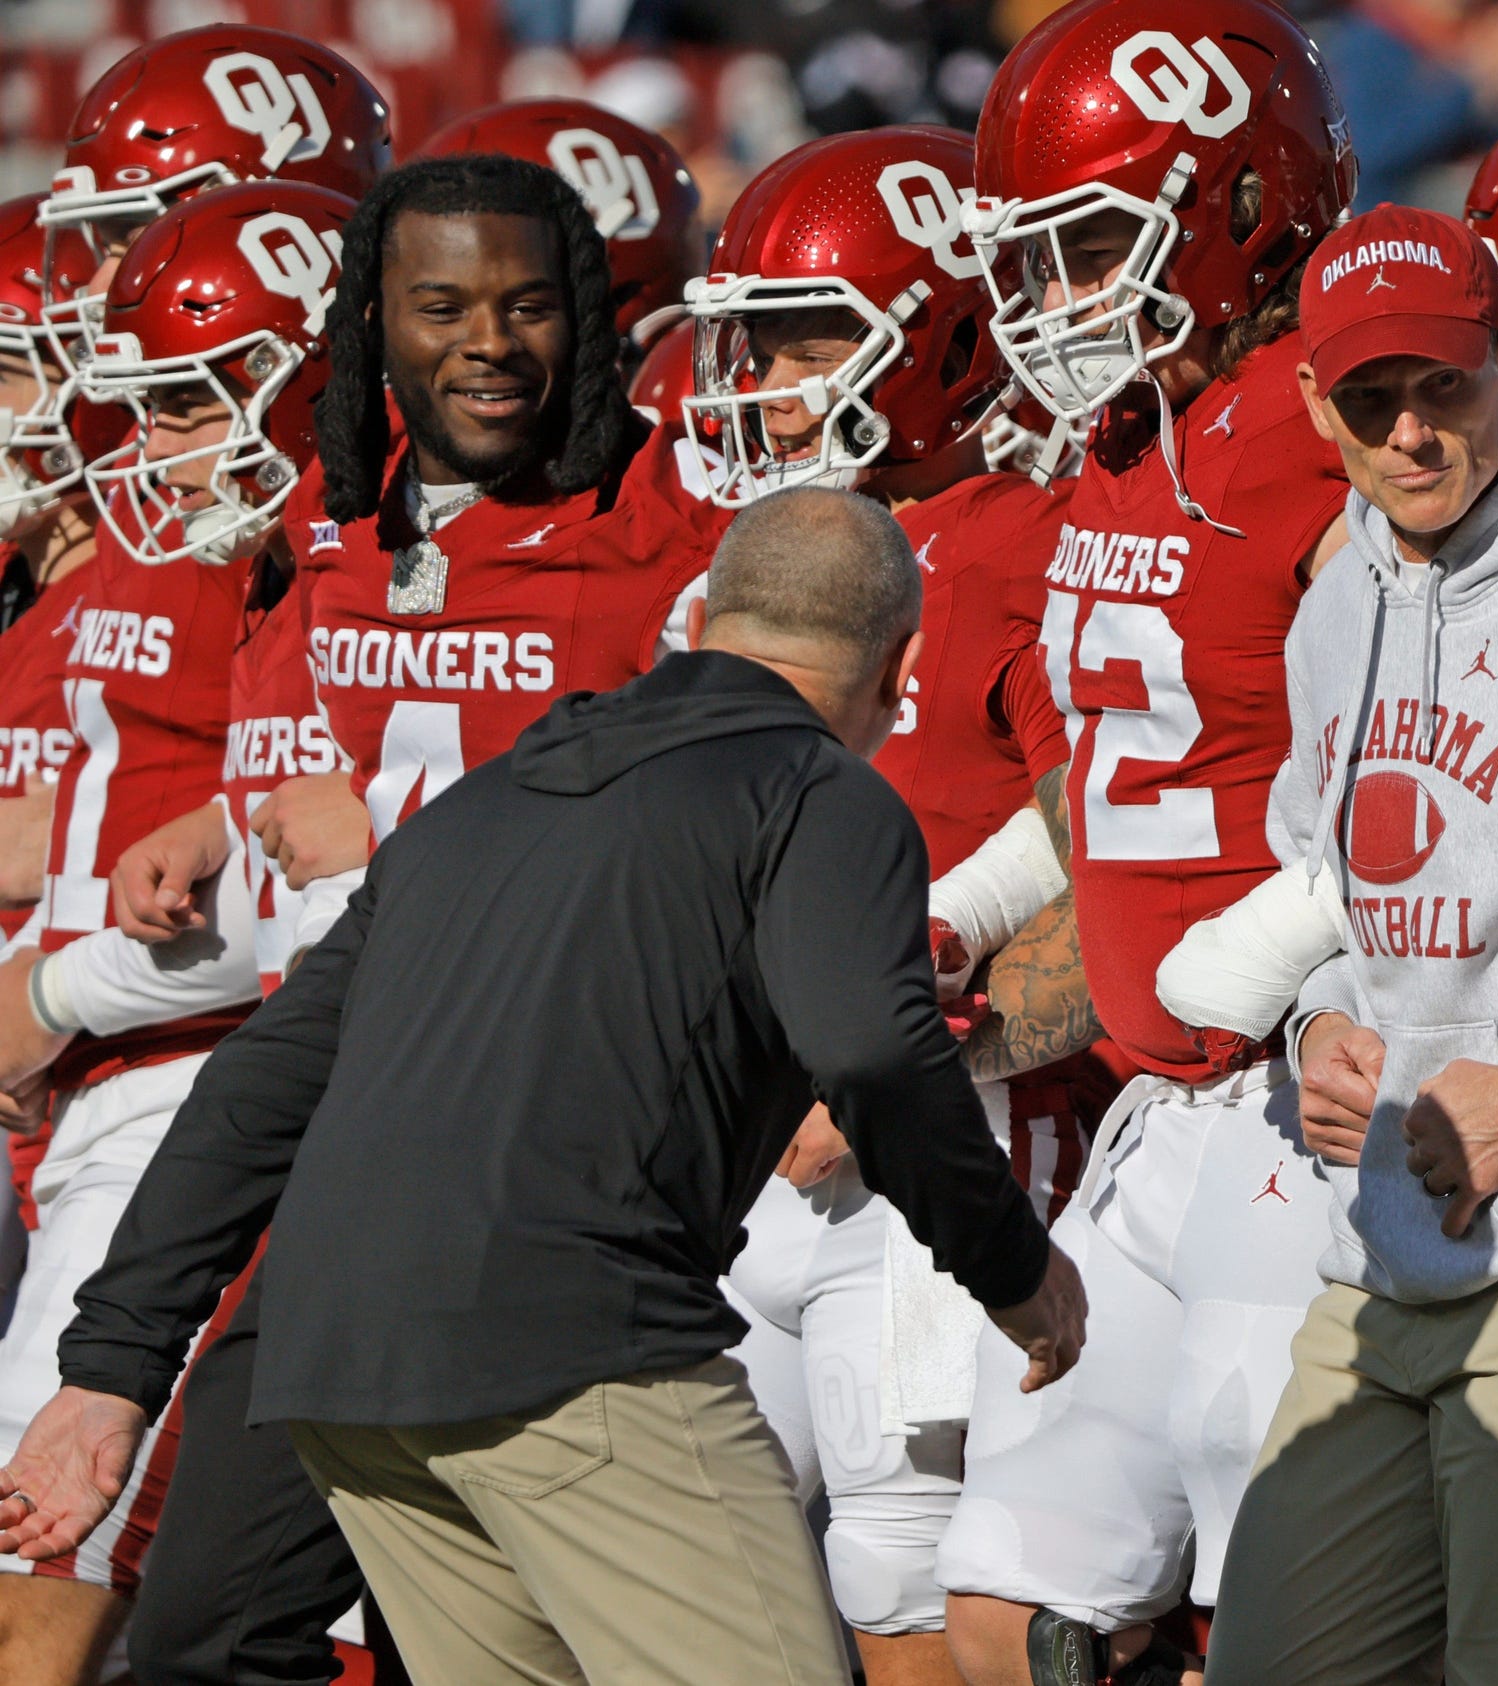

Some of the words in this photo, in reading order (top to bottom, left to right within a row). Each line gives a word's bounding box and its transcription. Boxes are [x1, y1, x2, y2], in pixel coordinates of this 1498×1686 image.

[204, 52, 331, 163] OU
[1111, 30, 1252, 139] OU
[547, 128, 660, 240] OU
[237, 211, 342, 308] O
[1322, 240, 1451, 292] OKLAHOMA
[311, 627, 554, 691] SOONERS
[1038, 589, 1220, 859] 12
[1344, 896, 1487, 960] OTBALL
[1063, 1625, 1080, 1686] ONJOY
